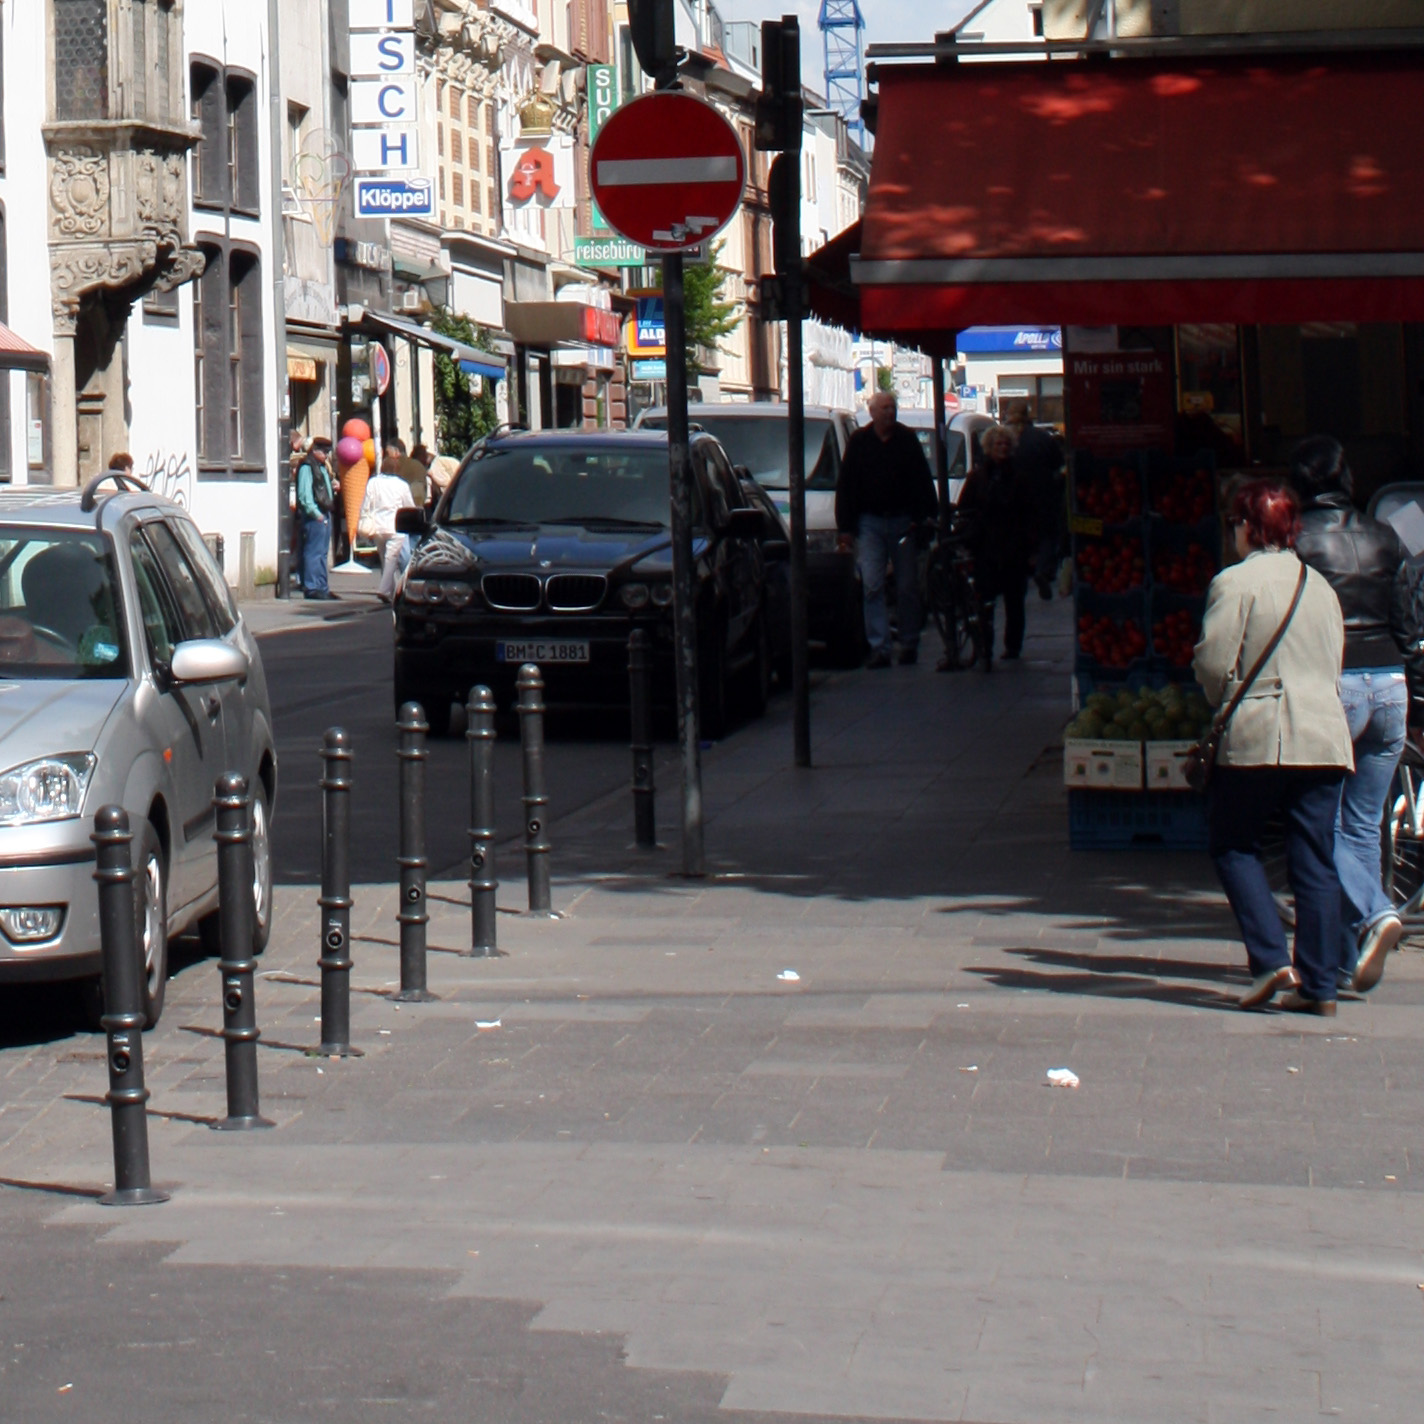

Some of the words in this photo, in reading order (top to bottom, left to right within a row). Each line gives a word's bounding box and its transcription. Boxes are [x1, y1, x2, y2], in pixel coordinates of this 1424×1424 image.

[361, 188, 429, 210] Klöppel
[576, 240, 642, 260] reisebüro
[639, 328, 666, 340] ALD
[1073, 360, 1098, 374] Mir
[1102, 360, 1123, 374] sin
[1127, 359, 1163, 373] stark
[962, 386, 971, 396] P
[550, 644, 587, 660] 1881
